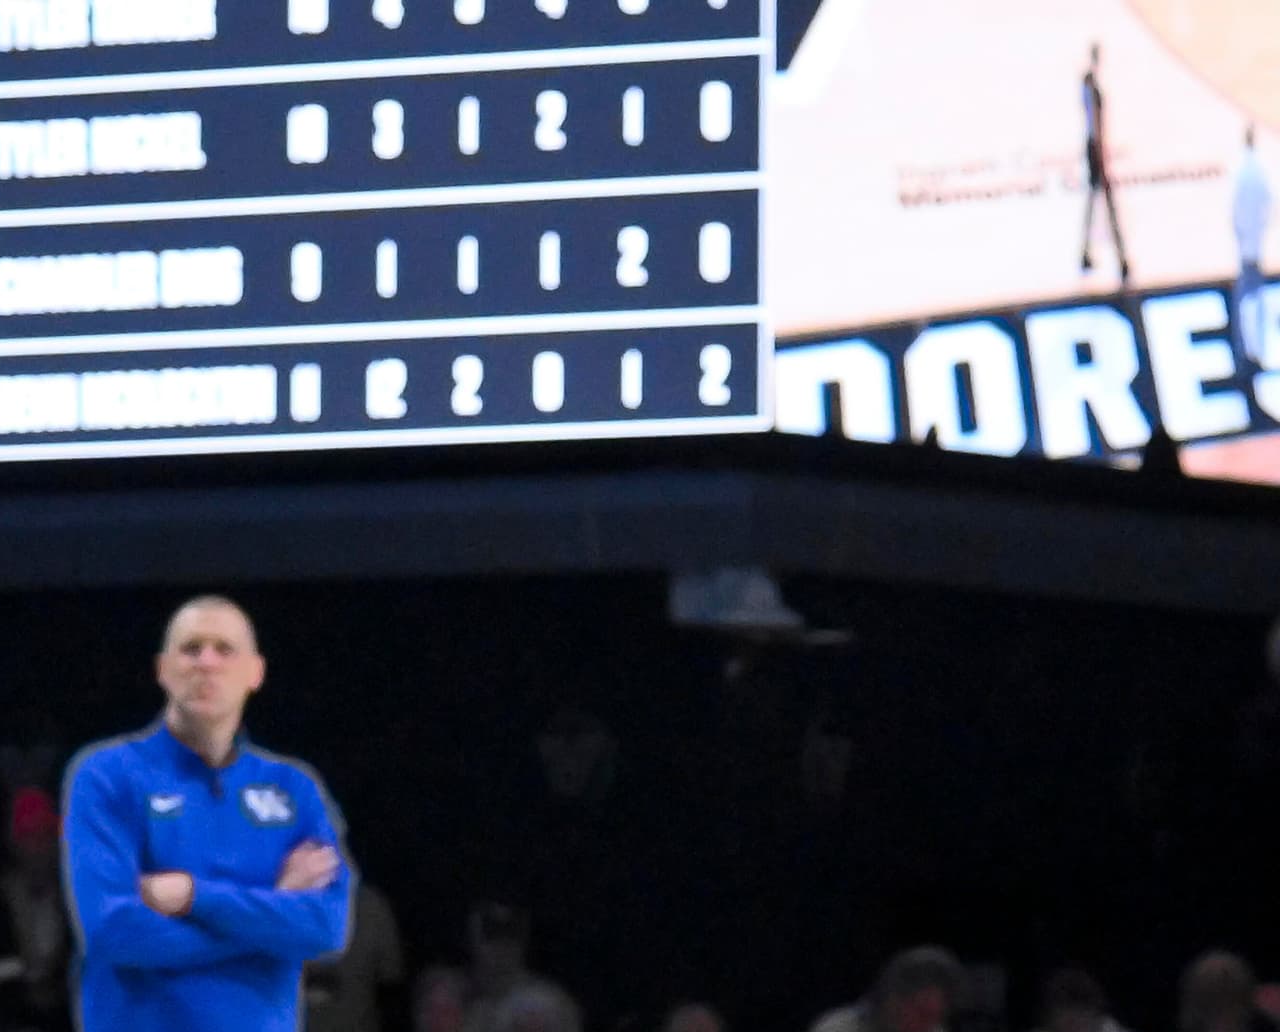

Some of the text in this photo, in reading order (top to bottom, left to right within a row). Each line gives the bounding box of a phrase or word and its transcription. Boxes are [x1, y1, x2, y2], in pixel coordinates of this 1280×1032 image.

[457, 96, 481, 156] 1
[534, 89, 568, 152] 2
[621, 86, 645, 147] 1
[375, 238, 399, 299] 1
[456, 235, 480, 295] 1
[538, 231, 562, 291] 1
[615, 225, 650, 288] 2
[450, 354, 484, 417] 2
[620, 348, 644, 410] 1
[697, 343, 732, 407] 2
